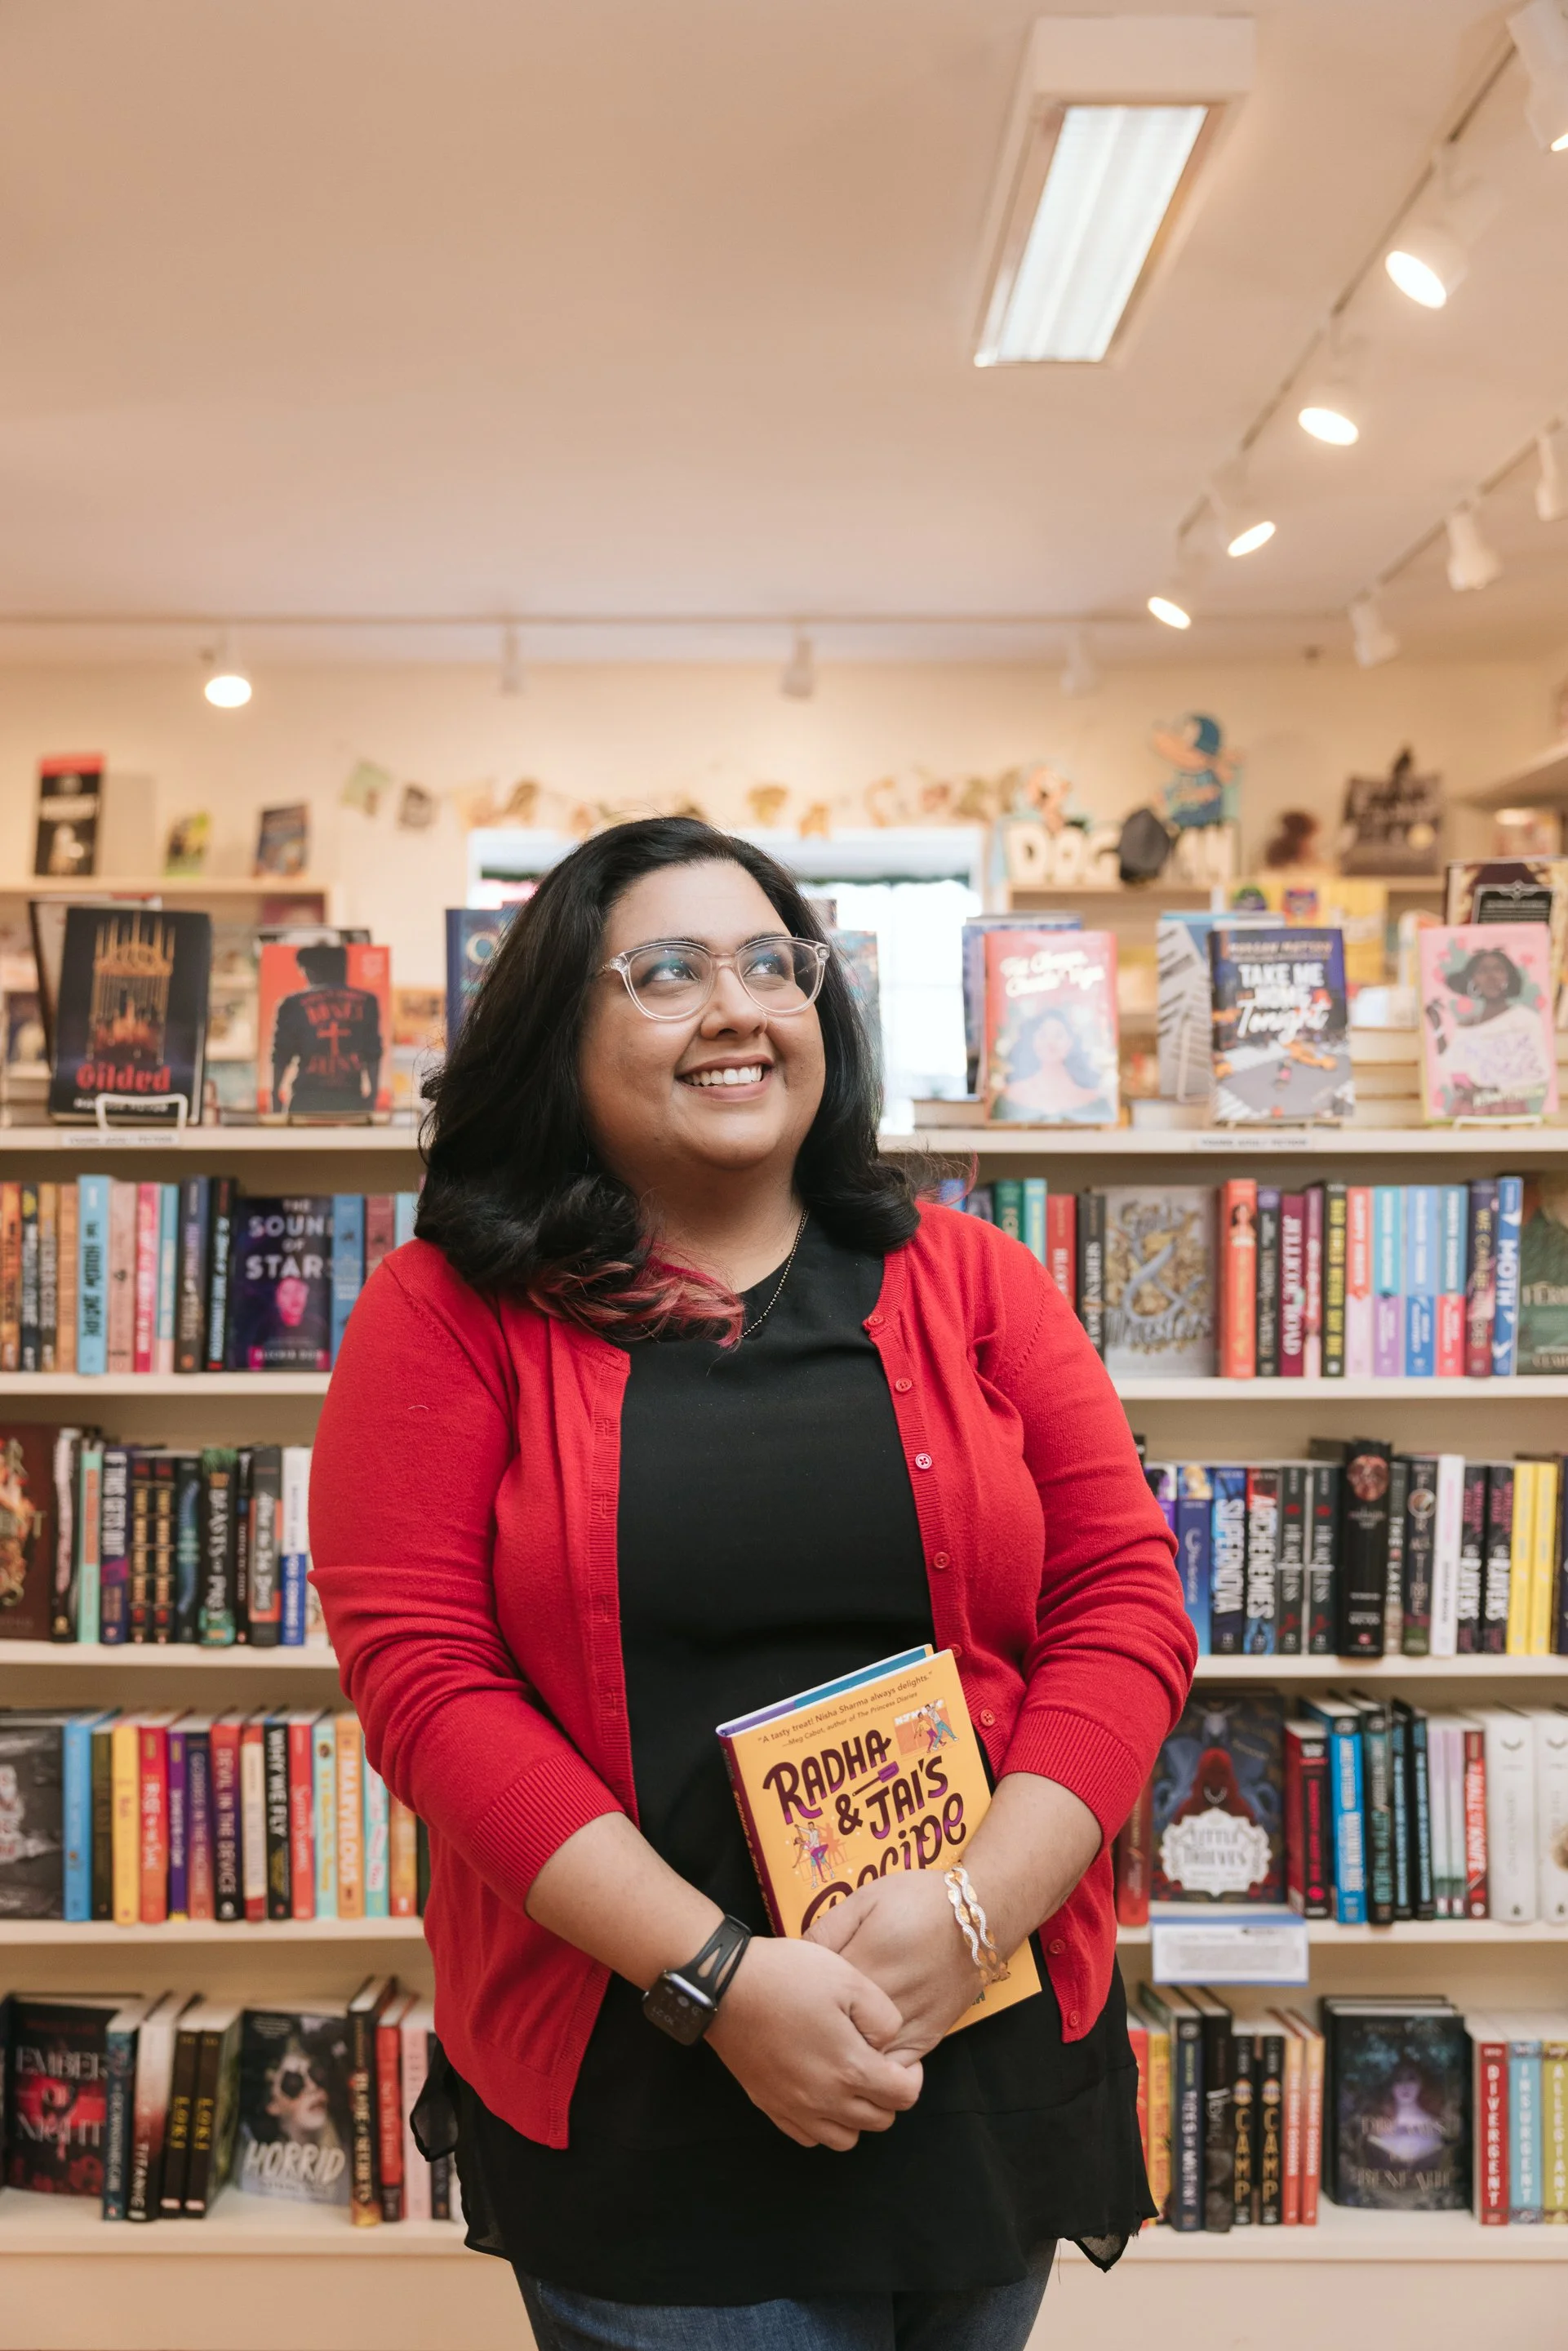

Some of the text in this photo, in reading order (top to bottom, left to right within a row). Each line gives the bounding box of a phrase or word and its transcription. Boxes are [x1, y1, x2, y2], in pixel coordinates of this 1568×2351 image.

[1239, 964, 1323, 987] TAKE ME
[1236, 999, 1328, 1041] Tonight
[76, 1064, 171, 1093] Gilded
[248, 1215, 333, 1238] SOUN
[282, 1197, 312, 1213] THE
[1477, 1209, 1491, 1233] WE
[246, 1255, 333, 1280] STAR
[282, 1238, 307, 1253] OF
[1474, 1235, 1490, 1268] CAN
[1497, 1238, 1517, 1308] MOTH
[103, 1467, 127, 1495] THIS
[103, 1496, 127, 1529] GETS
[209, 1489, 229, 1557] BEASTS
[103, 1530, 127, 1556] OUT
[1215, 1500, 1246, 1614] SUPERNOVA
[1249, 1496, 1277, 1619] ARCHENEMIES
[1279, 1523, 1303, 1602] HEARTLESS
[1309, 1523, 1333, 1602] HEARTLESS
[206, 1575, 229, 1621] PREY
[1388, 1562, 1402, 1603] LAKE
[771, 1727, 791, 1740] tasty
[792, 1718, 815, 1732] treat!
[815, 1709, 838, 1723] Nisha
[838, 1701, 869, 1715] Sharma
[870, 1688, 896, 1704] always
[804, 1728, 825, 1742] Cabot,
[826, 1720, 847, 1733] author
[848, 1713, 856, 1724] of
[856, 1709, 869, 1719] The
[869, 1700, 896, 1715] Princess
[896, 1691, 918, 1706] Diaries
[267, 1728, 288, 1838] WHY WE FLY
[762, 1729, 892, 1825] RADHA
[834, 1755, 948, 1839] & JAI'S
[216, 1747, 237, 1894] DEVIL IN THE DEVICE
[171, 2095, 189, 2149] LOKI
[193, 2096, 213, 2150] LOKI
[1487, 2064, 1499, 2207] DIVERGENT
[1519, 2063, 1531, 2204] INSURGENT
[1552, 2064, 1566, 2205] ALLEGIANT
[244, 2138, 347, 2185] HORRID
[1234, 2108, 1251, 2204] CAMP
[1262, 2108, 1280, 2203] CAMP
